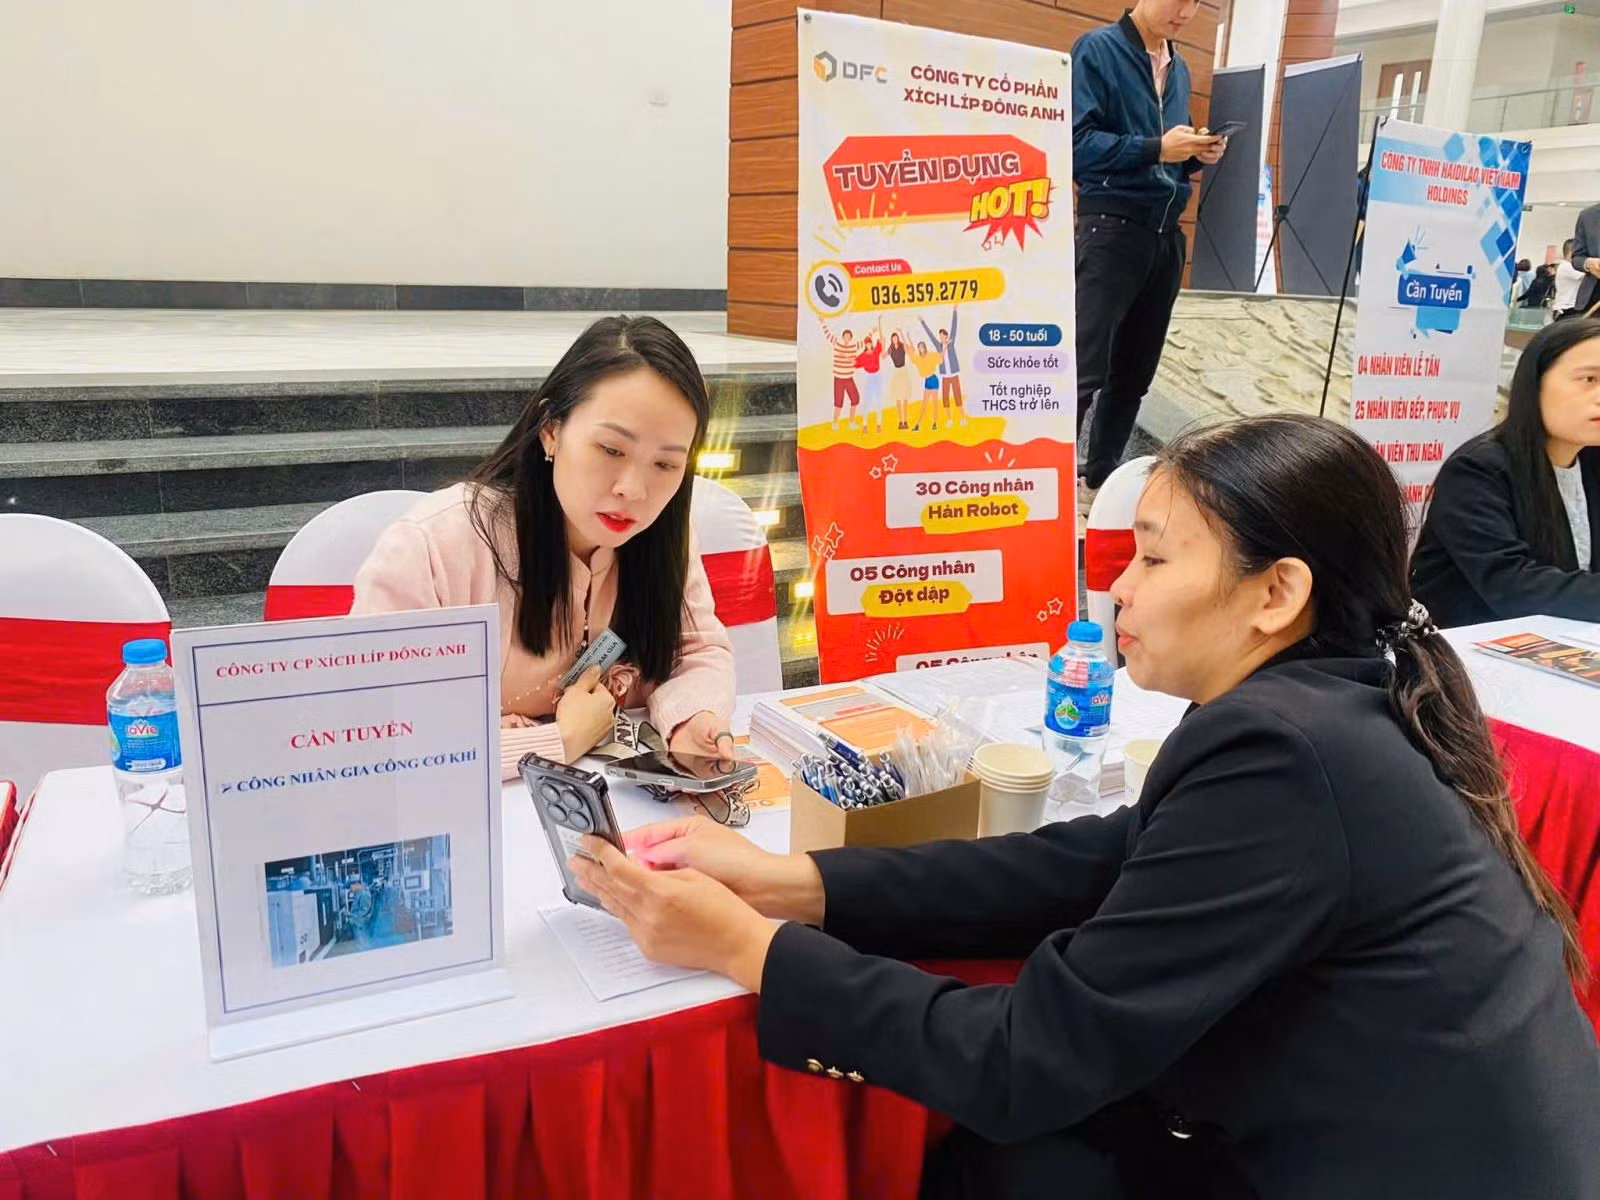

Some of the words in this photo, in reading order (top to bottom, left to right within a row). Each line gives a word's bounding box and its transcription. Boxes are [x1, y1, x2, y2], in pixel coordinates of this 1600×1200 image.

[842, 61, 888, 84] DFC
[910, 64, 959, 86] CÔNG
[962, 73, 986, 89] TY
[1013, 78, 1059, 100] PHẦN
[904, 86, 948, 106] XÍCH
[981, 98, 1029, 118] ĐÔNG
[1030, 105, 1065, 122] ANH
[834, 149, 943, 192] TUYỂN
[942, 151, 1021, 185] DỤNG
[1407, 156, 1417, 173] TY
[1418, 158, 1440, 178] TNHH
[1441, 161, 1480, 184] HAIDILAO
[969, 177, 1052, 223] HOT!
[1426, 184, 1469, 206] HOLDINGS
[854, 264, 889, 274] Contact
[890, 262, 902, 272] Us
[871, 279, 978, 306] 036.359.2779
[1406, 279, 1427, 299] Cần
[988, 329, 1001, 342] 18
[1009, 329, 1024, 342] 50
[987, 355, 1011, 369] Sức
[1042, 353, 1059, 368] tốt
[1358, 355, 1368, 376] 04
[989, 381, 1008, 397] Tốt
[1011, 383, 1052, 399] nghiệp
[982, 400, 1016, 412] THCS
[1019, 397, 1038, 411] trở
[1041, 398, 1059, 411] lên
[1355, 399, 1365, 420] 25
[1406, 443, 1421, 462] THU
[915, 481, 941, 496] 30
[945, 480, 990, 497] Công
[993, 477, 1034, 492] nhân
[967, 502, 1019, 518] Robot
[849, 566, 878, 582] 05
[881, 563, 929, 583] Công
[932, 560, 976, 577] nhân
[879, 588, 913, 606] Đột
[916, 585, 950, 604] dập
[216, 662, 264, 678] CÔNG
[267, 661, 289, 673] TY
[293, 657, 315, 671] CP
[318, 653, 356, 668] XÍCH
[361, 649, 385, 664] LÍP
[389, 646, 432, 661] ĐÔNG
[435, 644, 466, 656] ANH
[341, 720, 414, 744] TUYỂN
[236, 775, 286, 793] CÔNG
[290, 767, 337, 786] NHÂN
[340, 765, 370, 778] GIA
[373, 758, 419, 774] CÔNG
[422, 752, 447, 767] CƠ
[449, 747, 478, 764] KHÍ
